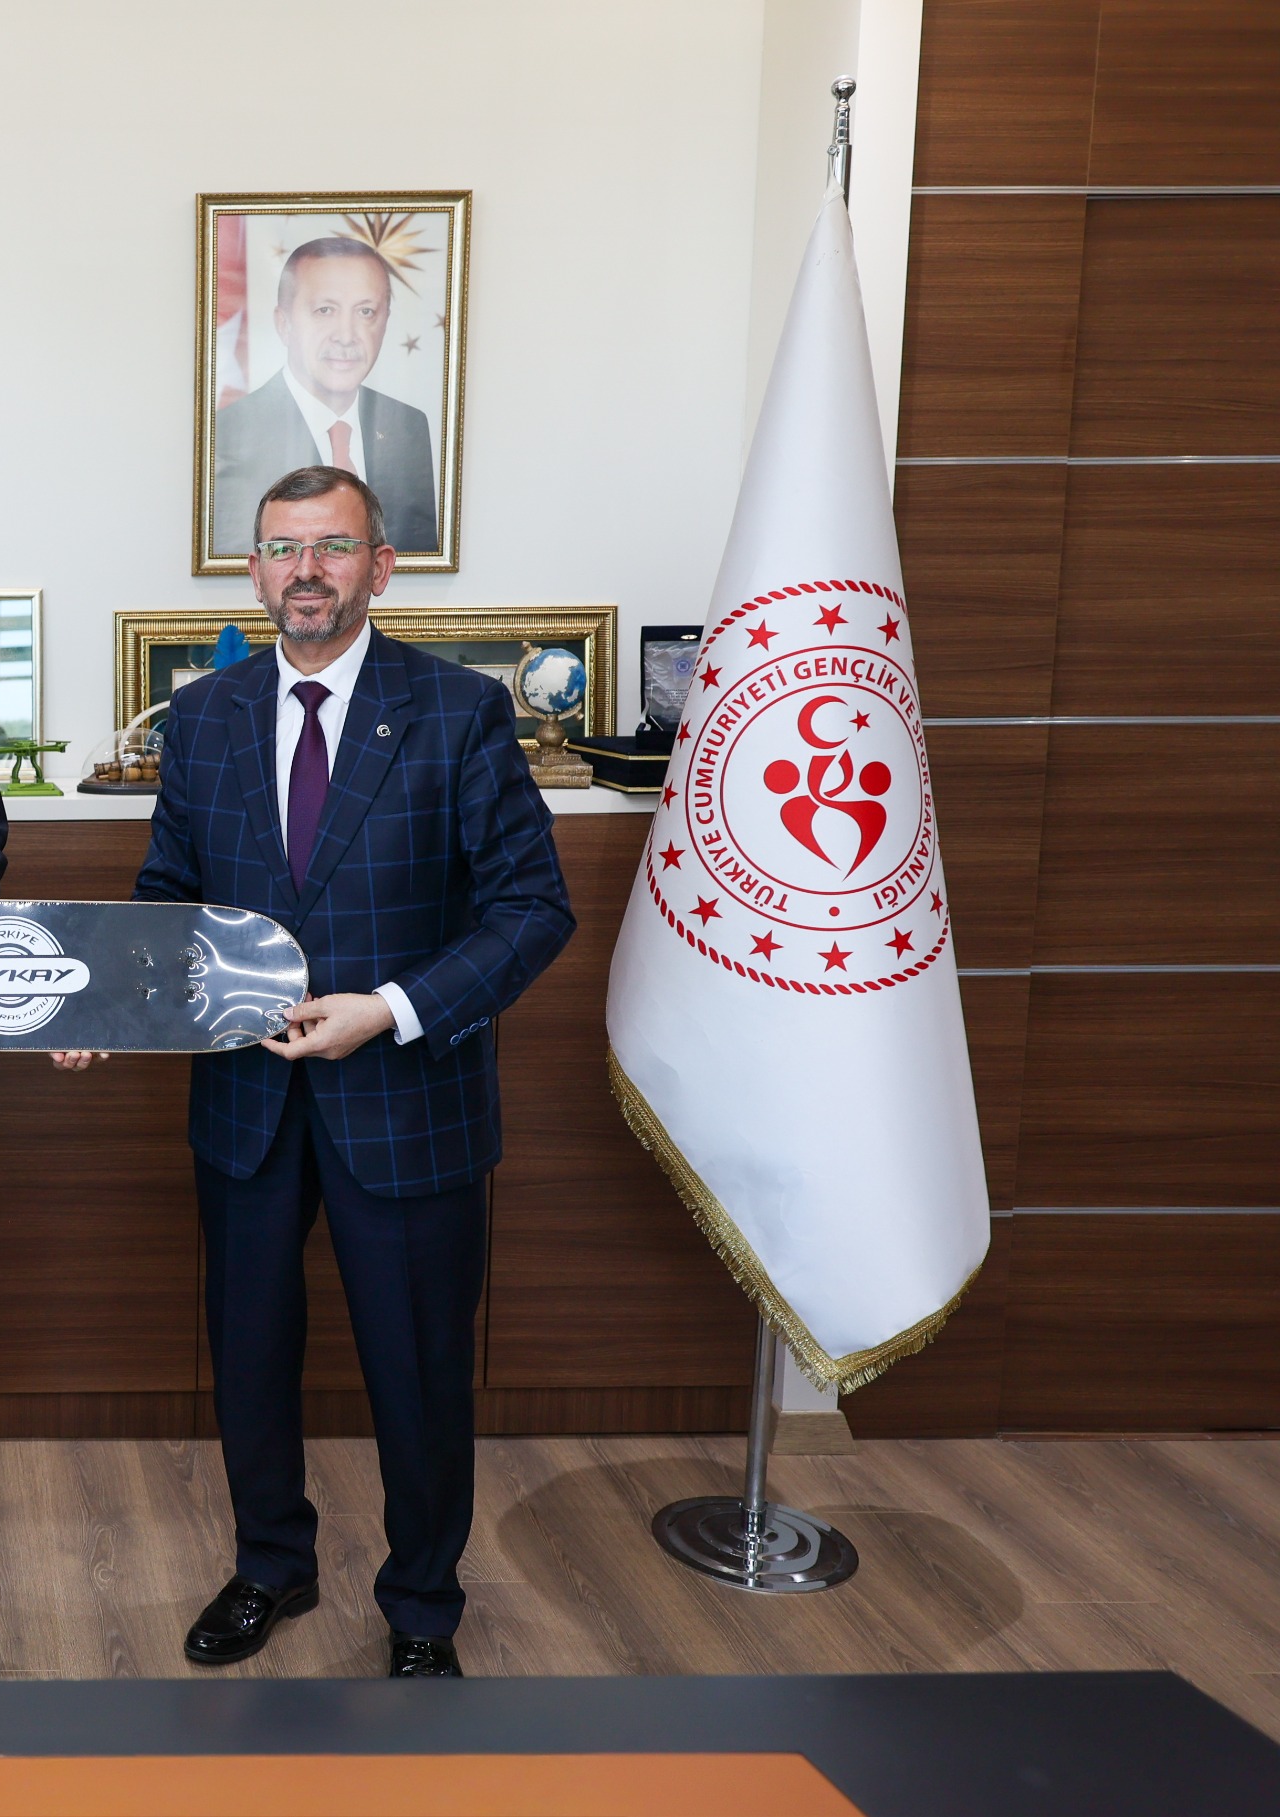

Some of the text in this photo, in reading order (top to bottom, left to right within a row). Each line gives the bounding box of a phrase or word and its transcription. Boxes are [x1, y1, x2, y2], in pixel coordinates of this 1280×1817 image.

[694, 657, 932, 912] TÜRKİYE CUMHURİYETİ GENÇLİK VE SPOR BAKANLIĞI
